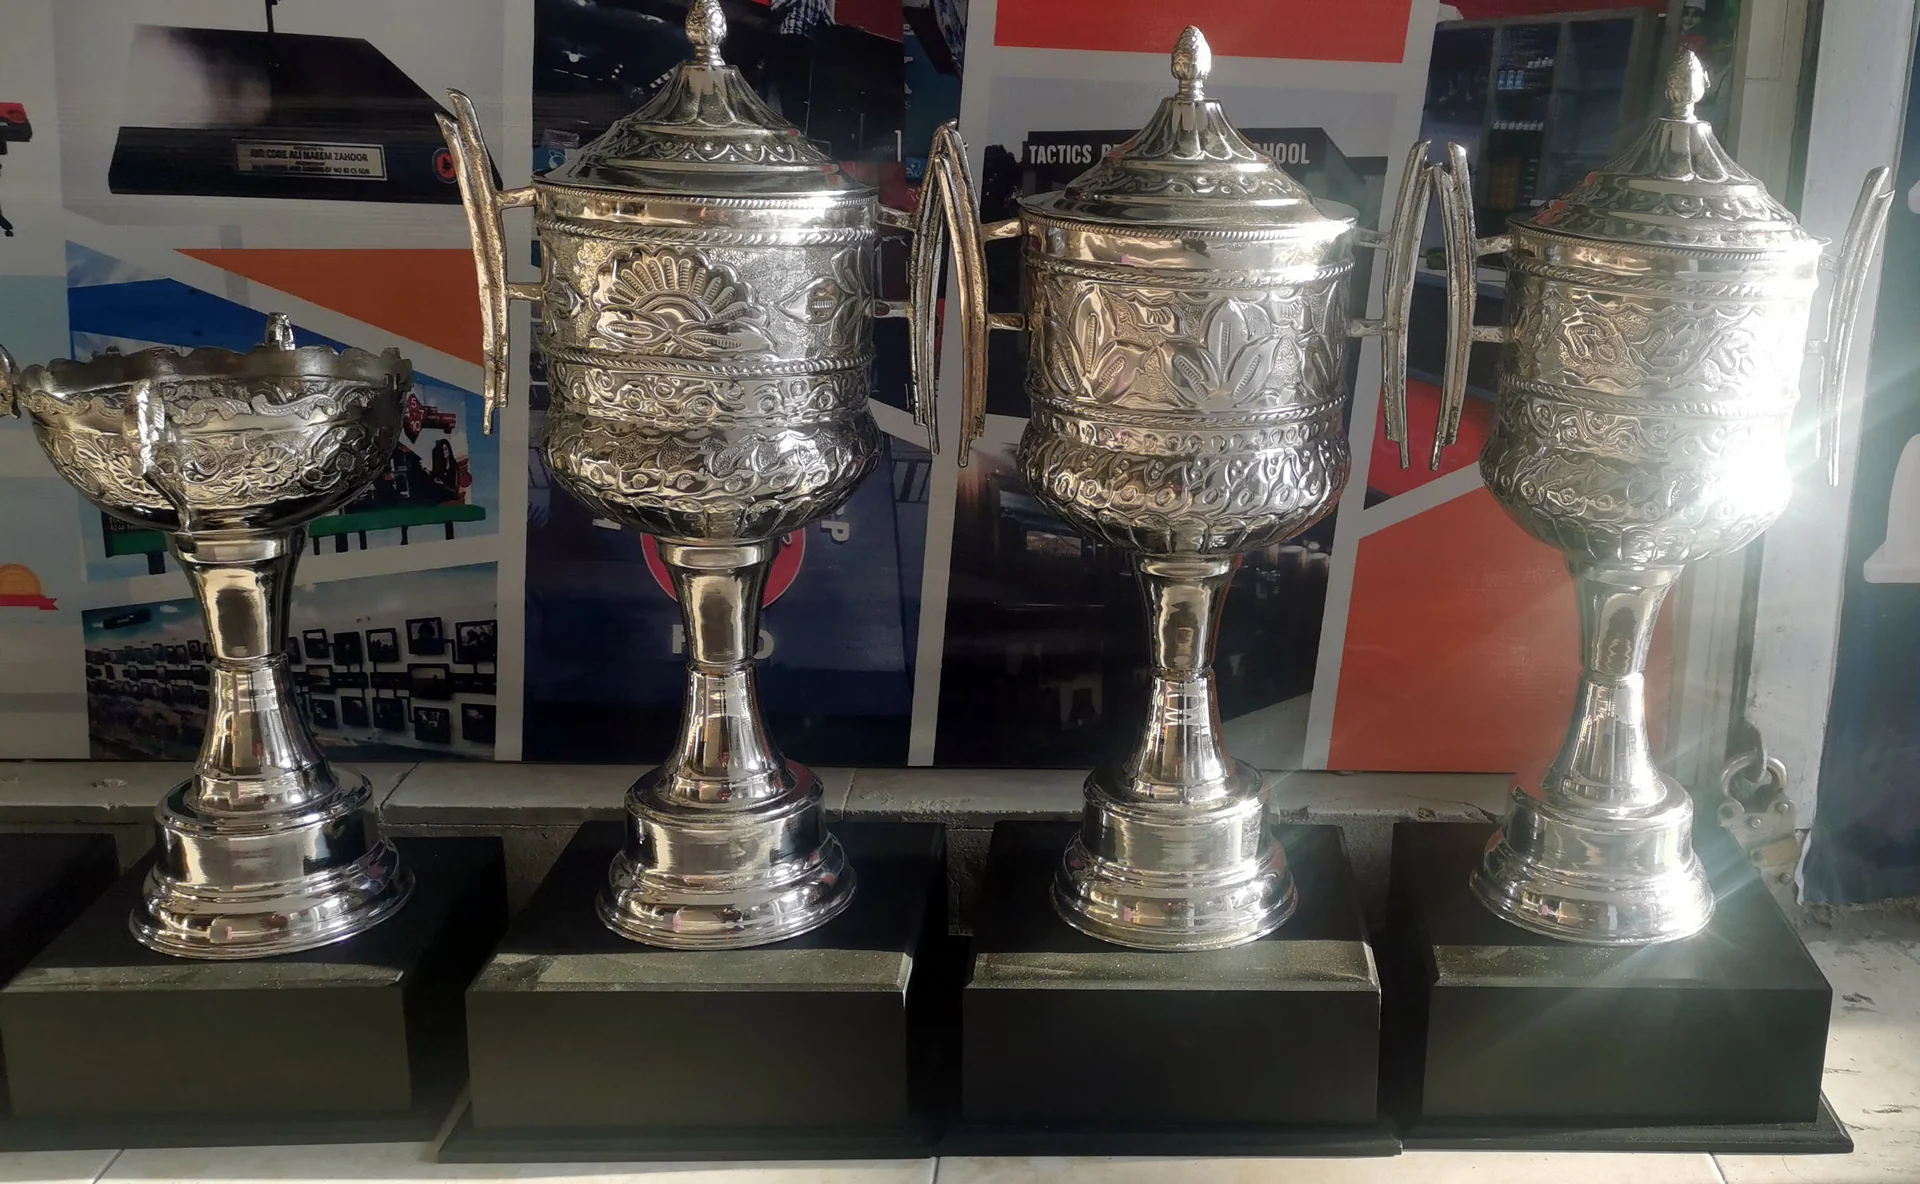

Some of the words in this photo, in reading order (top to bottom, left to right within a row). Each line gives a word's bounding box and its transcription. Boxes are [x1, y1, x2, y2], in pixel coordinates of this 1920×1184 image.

[334, 152, 368, 161] ZAHOOR
[1029, 145, 1092, 163] TACTICS
[1252, 143, 1310, 164] HOOL
[411, 397, 417, 408] 5
